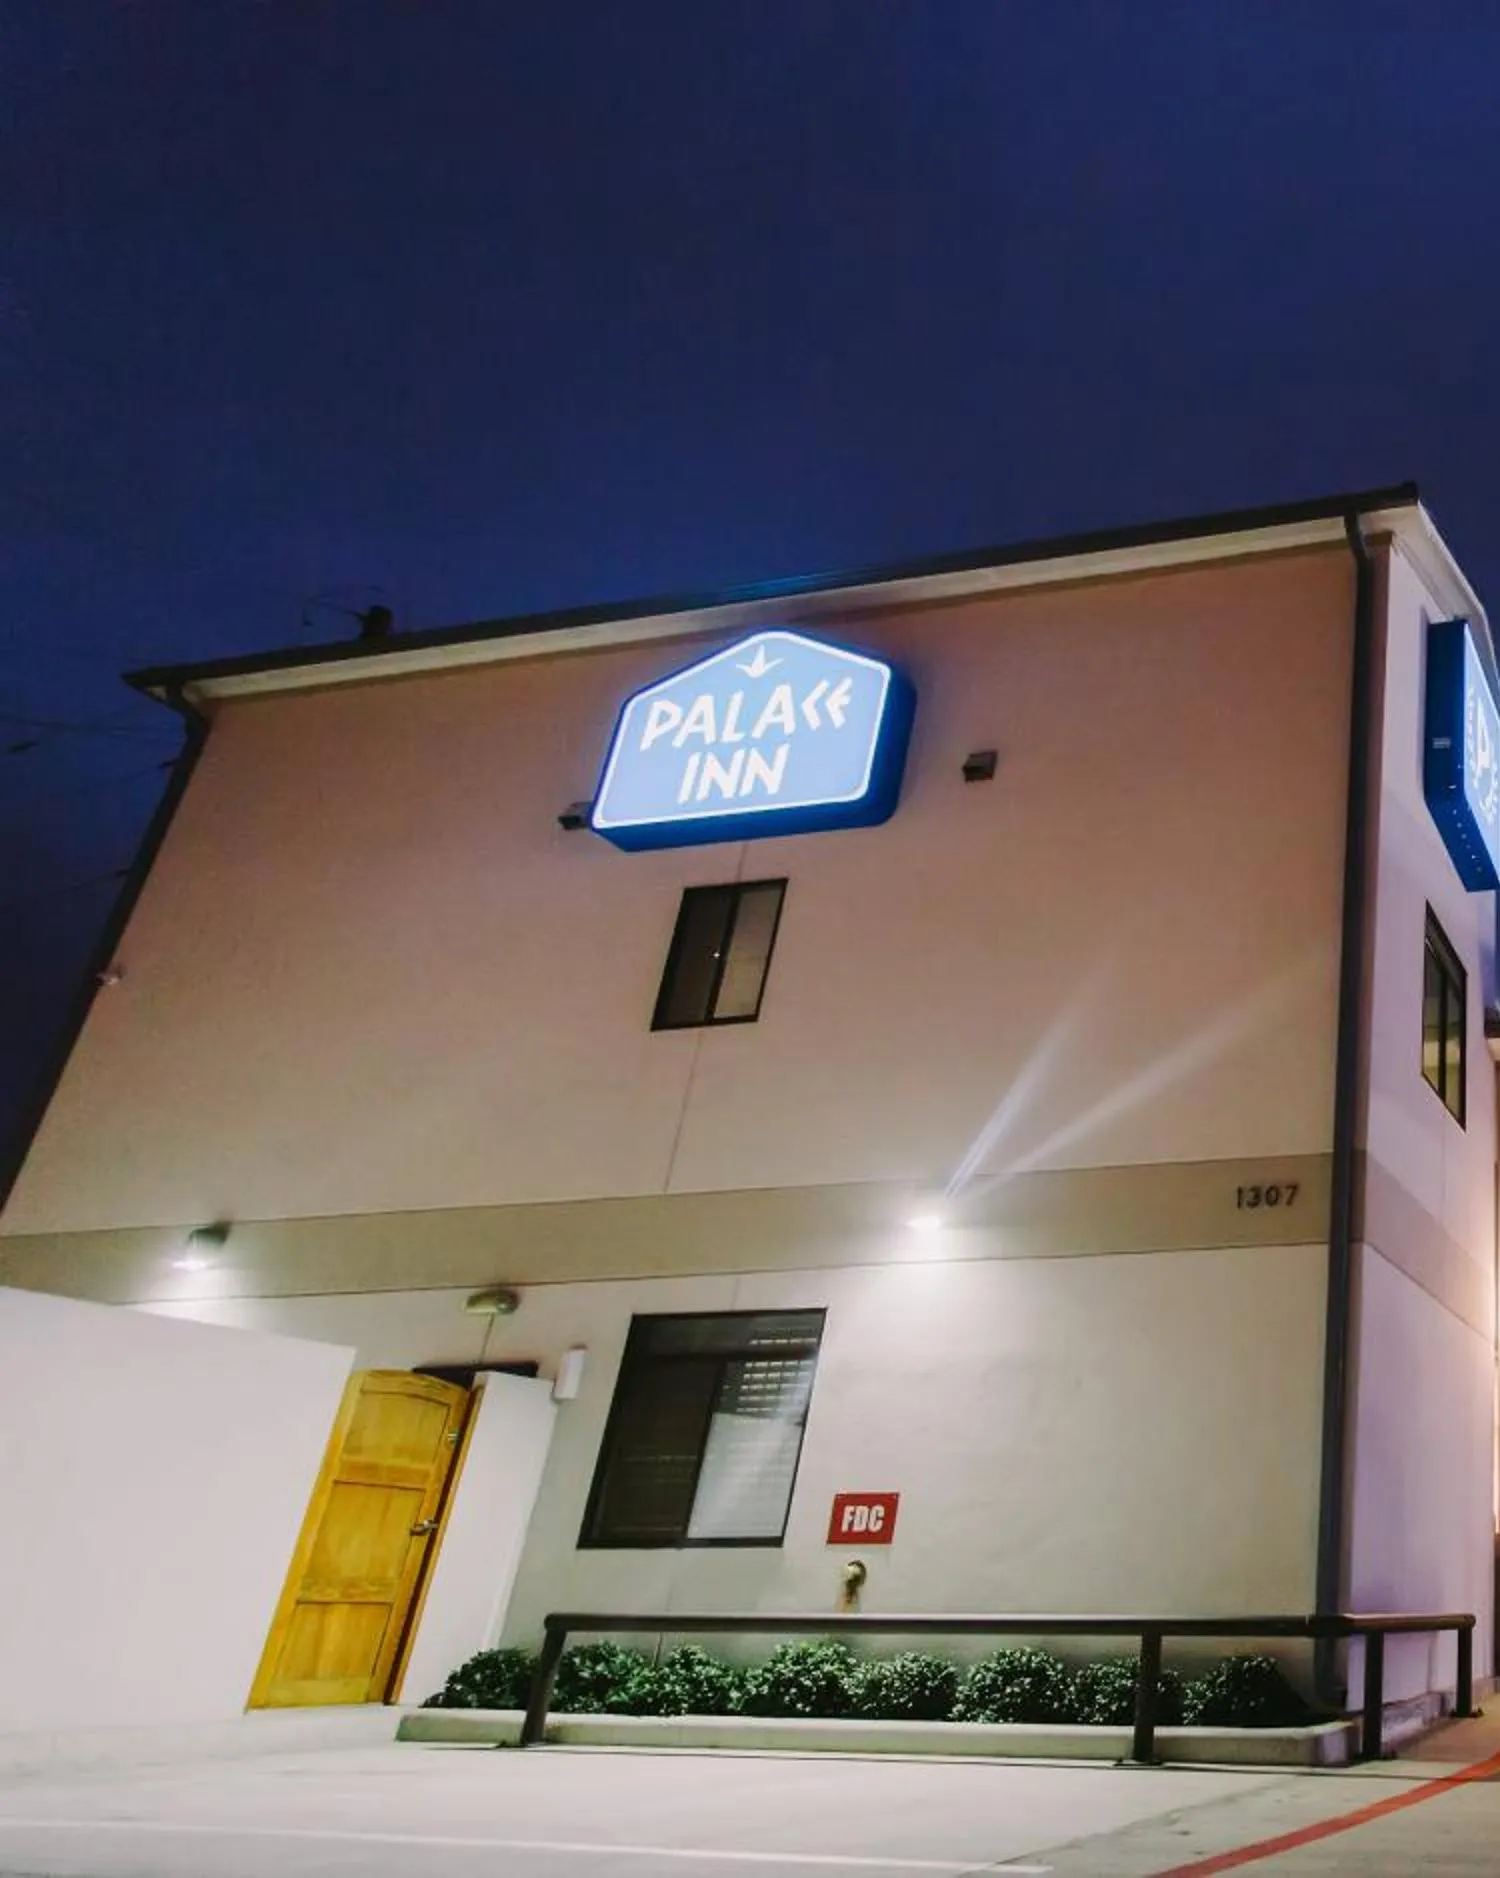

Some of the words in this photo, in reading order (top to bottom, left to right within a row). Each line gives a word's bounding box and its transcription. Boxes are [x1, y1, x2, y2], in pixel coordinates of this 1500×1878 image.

[640, 677, 853, 751] PALACE
[678, 743, 791, 804] INN
[1236, 1184, 1298, 1209] 1307
[841, 1504, 885, 1532] FDC
